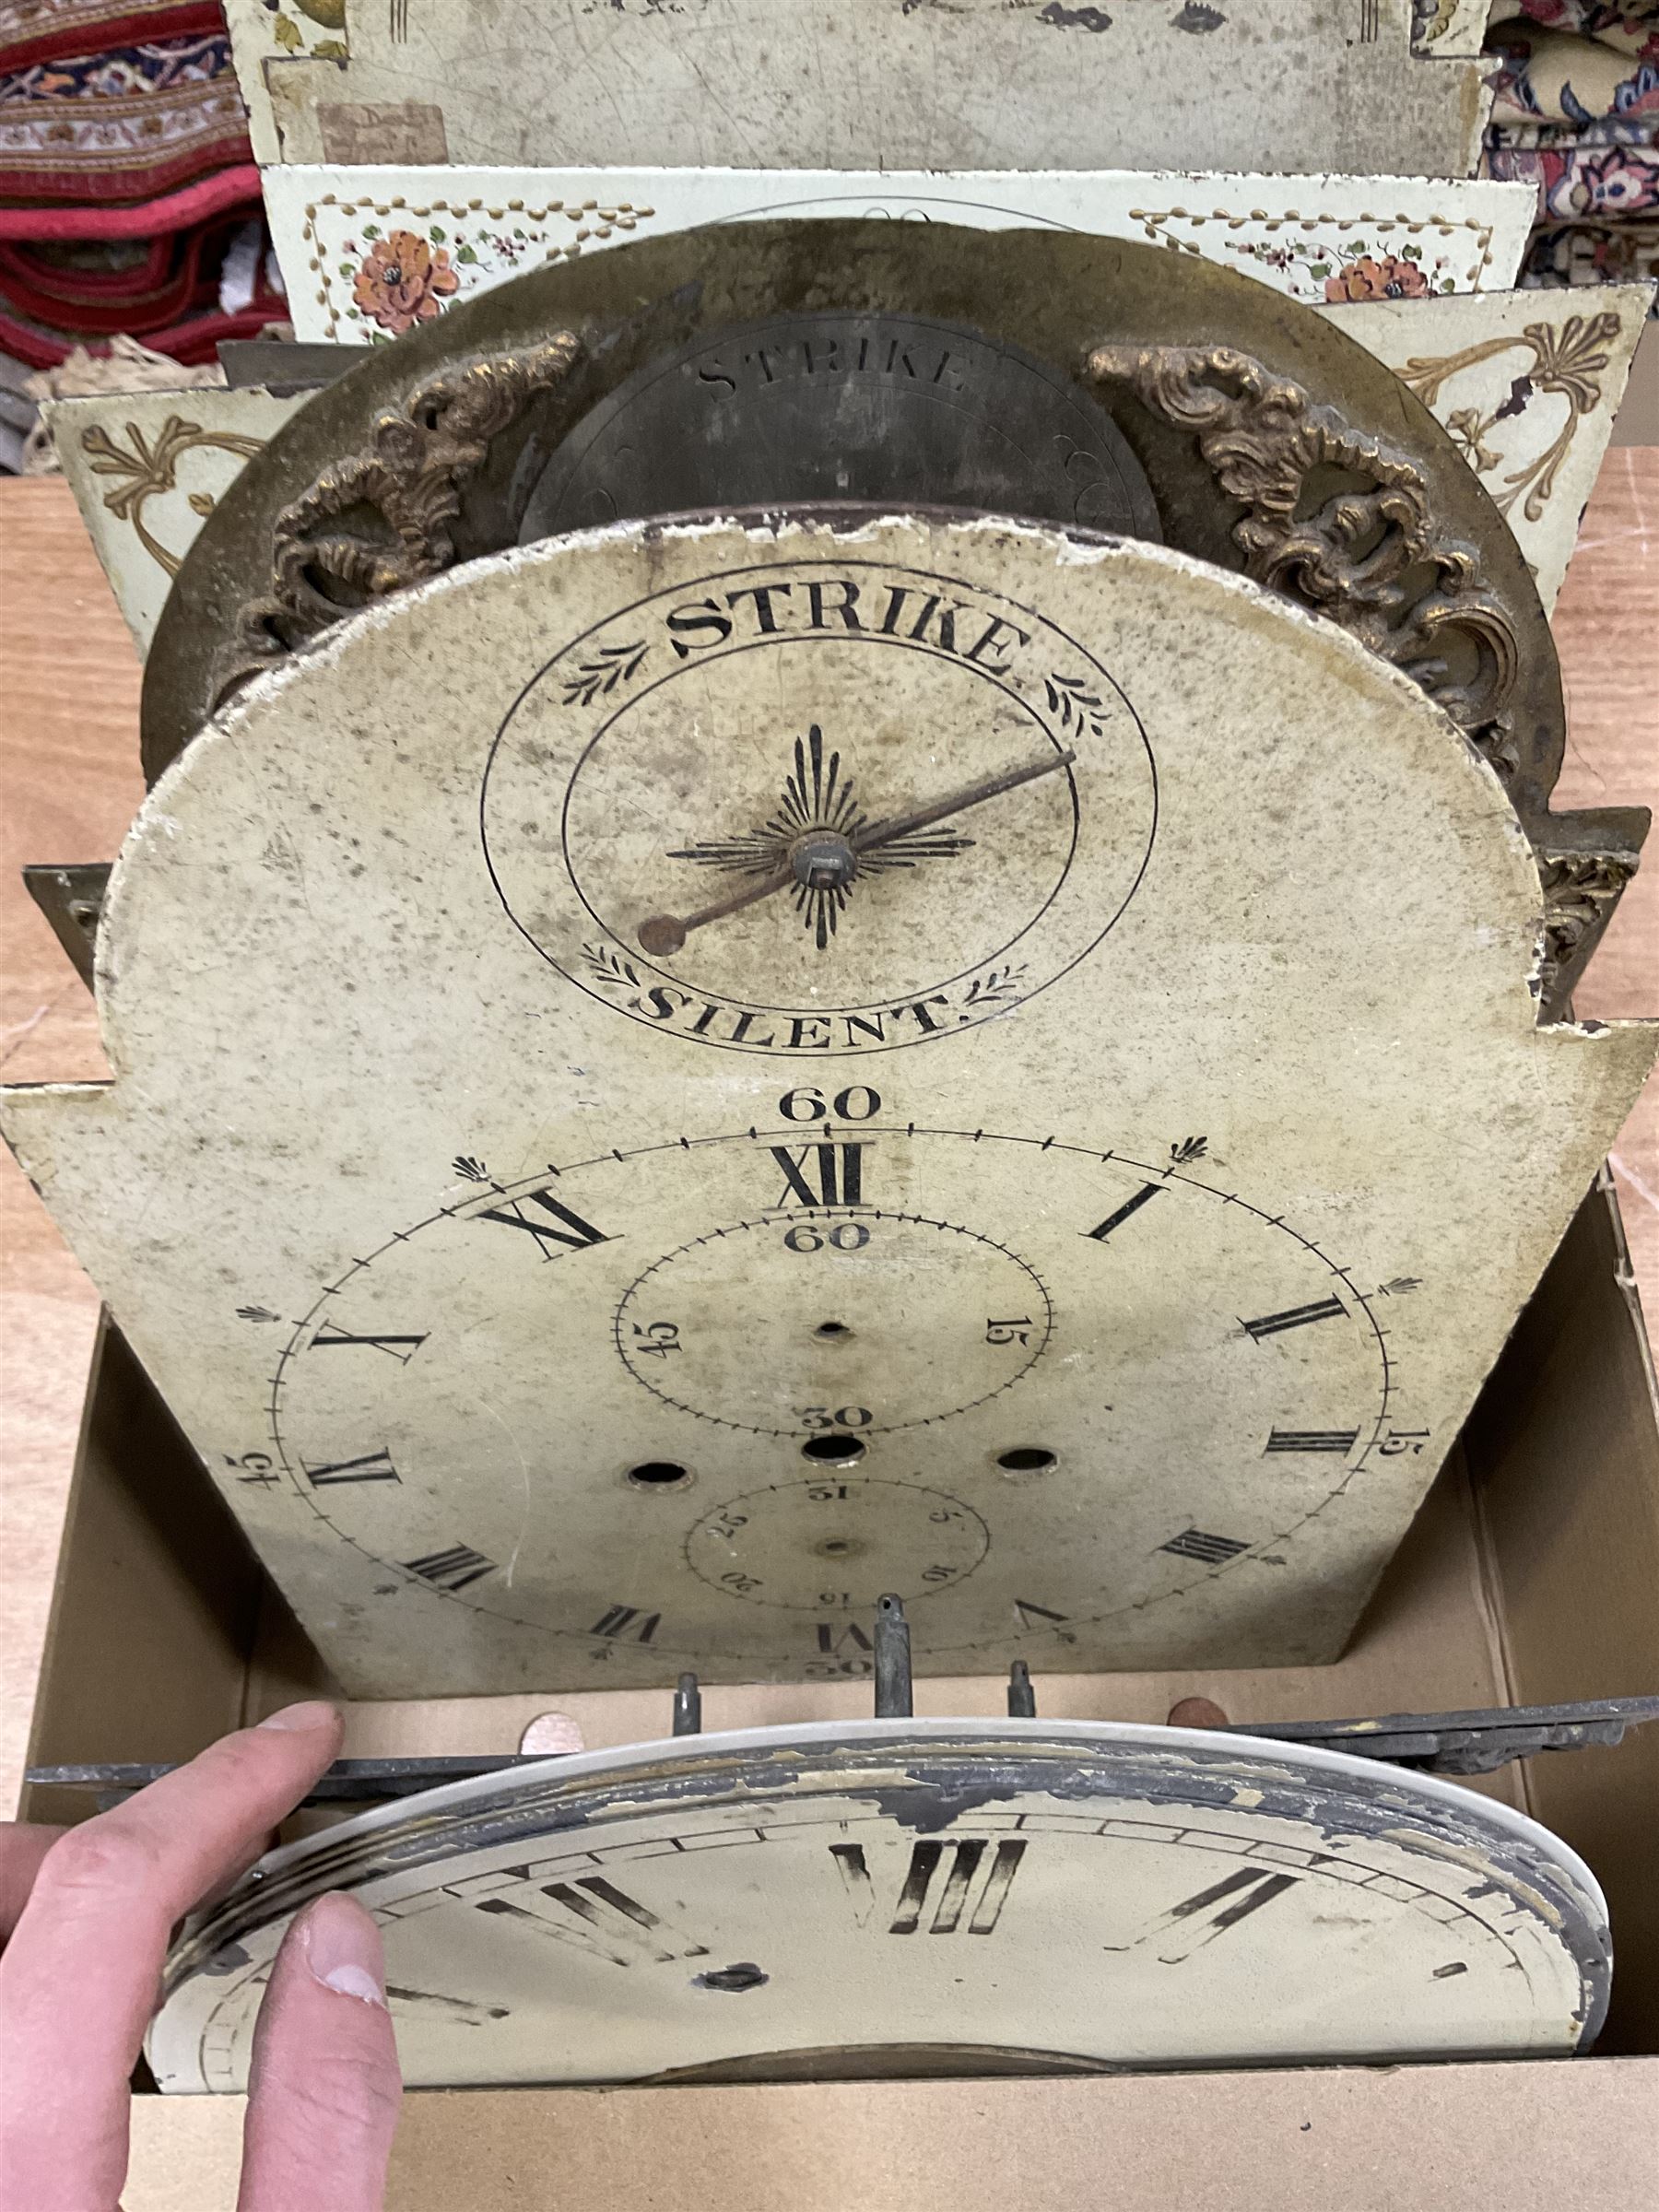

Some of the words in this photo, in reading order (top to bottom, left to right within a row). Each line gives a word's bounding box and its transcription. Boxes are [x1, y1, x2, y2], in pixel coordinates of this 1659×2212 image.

[698, 336, 973, 404] STRIKE
[665, 579, 1031, 660] STRIKE
[779, 1085, 881, 1123] 60
[754, 1141, 877, 1211] XII
[465, 1185, 625, 1264] XI
[1077, 1180, 1171, 1243] I
[783, 1222, 870, 1253] 60
[985, 1315, 1033, 1347] 15
[1236, 1292, 1351, 1346] II
[306, 1319, 432, 1366] X
[633, 1320, 681, 1359] 45
[802, 1406, 872, 1430] 30
[1261, 1425, 1361, 1459] III
[1379, 1428, 1430, 1456] 15
[221, 1452, 281, 1491] 45
[298, 1447, 403, 1489] IX
[707, 1512, 748, 1538] 25
